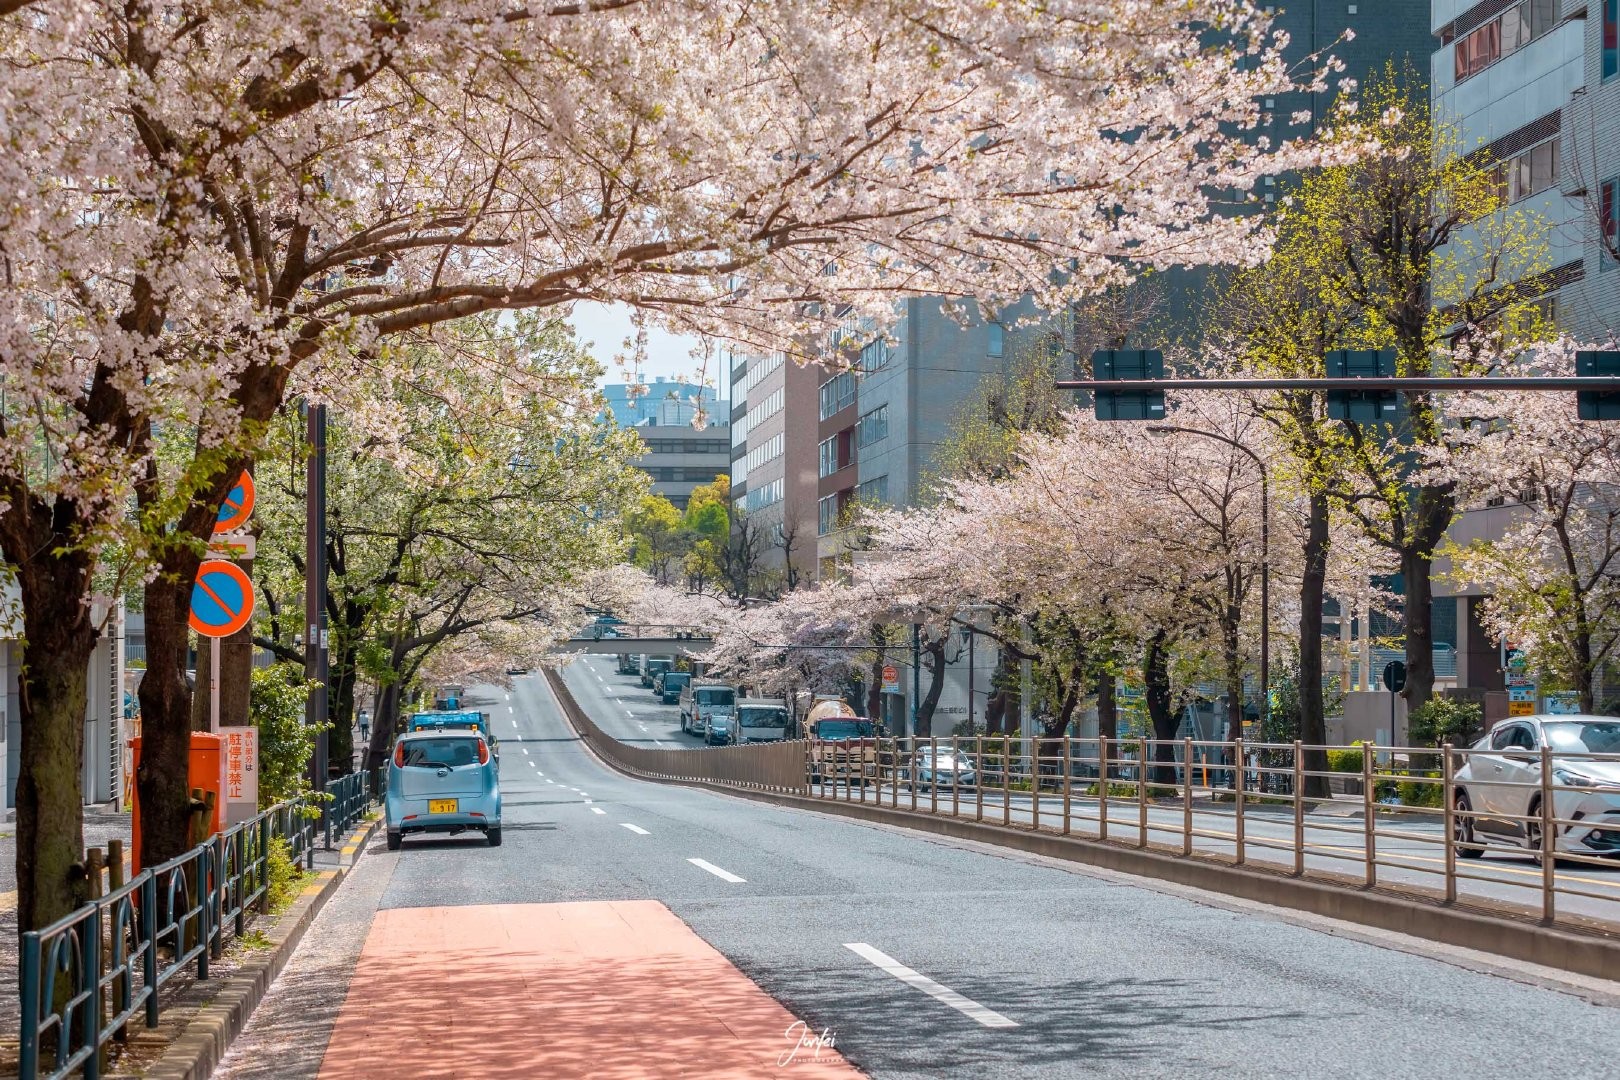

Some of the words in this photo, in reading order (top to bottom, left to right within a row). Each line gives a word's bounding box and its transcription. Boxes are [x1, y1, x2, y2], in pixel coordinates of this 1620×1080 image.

[229, 732, 242, 798] 駐停車禁止
